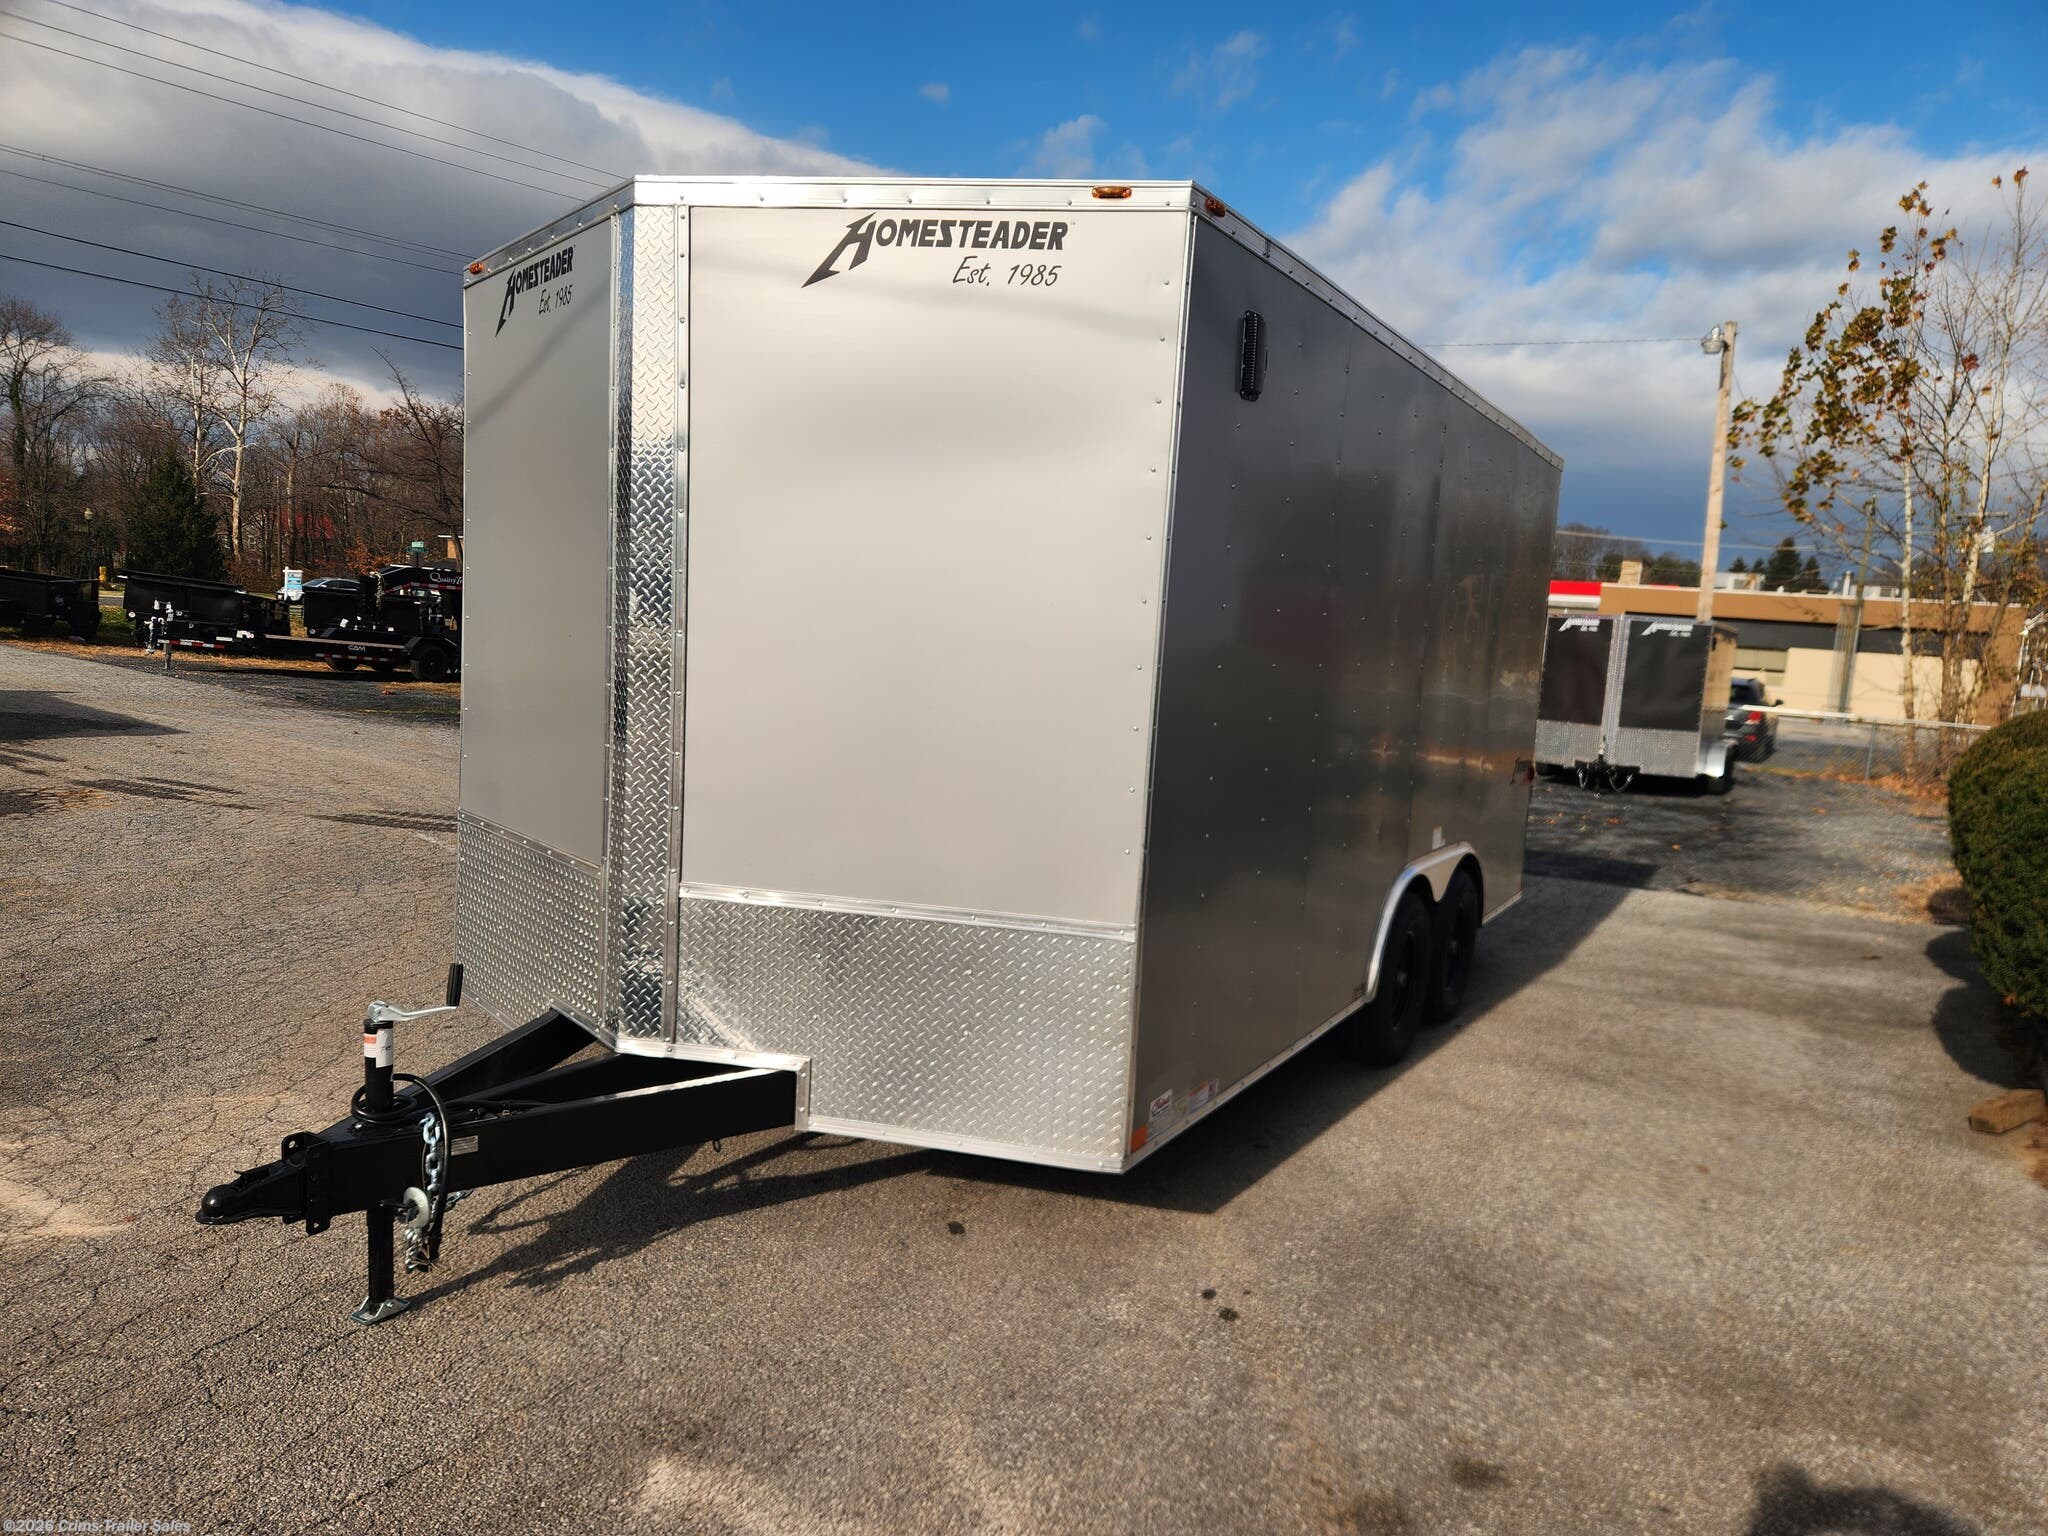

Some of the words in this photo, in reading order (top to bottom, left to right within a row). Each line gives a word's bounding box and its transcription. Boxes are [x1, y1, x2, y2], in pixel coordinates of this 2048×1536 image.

[801, 211, 1068, 288] HOMESTEADER
[495, 246, 575, 337] HOMESTEADER
[555, 284, 573, 309] 1985
[1007, 264, 1062, 287] 1985
